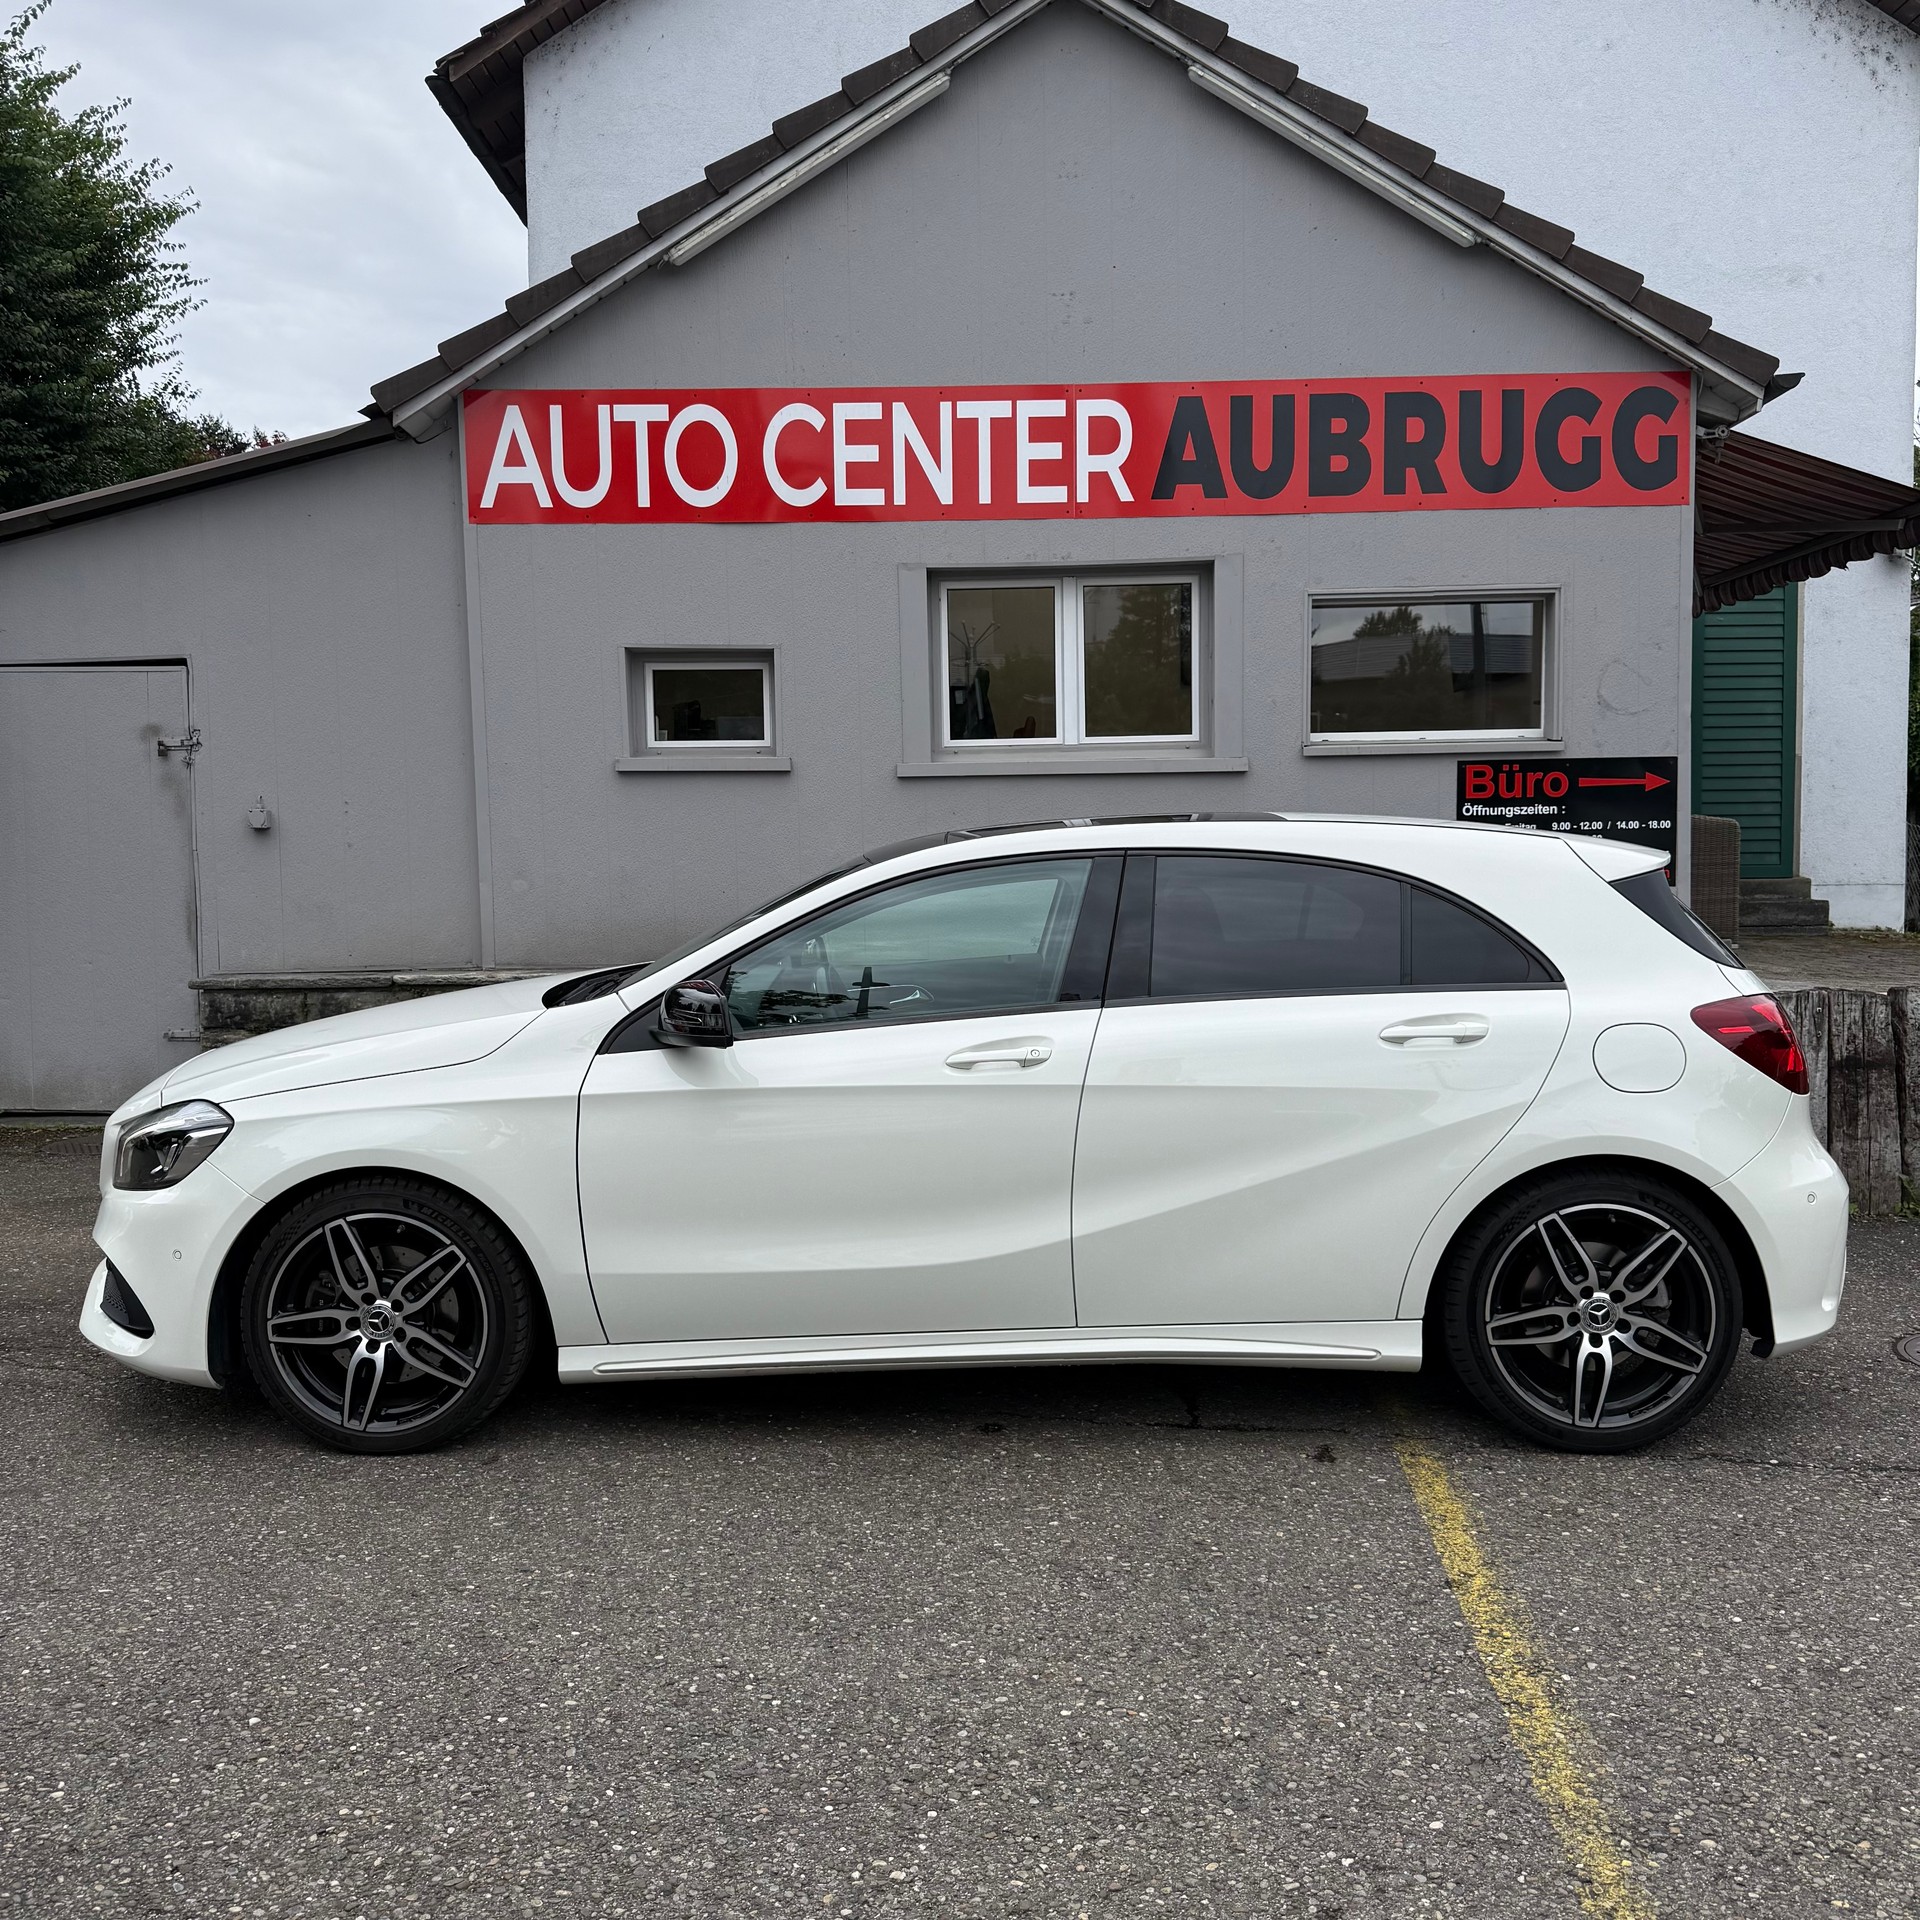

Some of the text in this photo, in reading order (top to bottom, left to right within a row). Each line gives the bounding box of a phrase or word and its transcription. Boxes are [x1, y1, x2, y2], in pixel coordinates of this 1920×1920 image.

[480, 386, 1680, 508] AUTO CENTER AUBRUGG
[1465, 764, 1569, 799] Büro
[1462, 803, 1558, 817] Öffnungszeiten
[1552, 822, 1571, 831] 9.00
[1579, 821, 1603, 830] 12.00
[1616, 820, 1639, 829] 14.00
[1648, 820, 1671, 829] 18.00
[420, 1204, 477, 1249] MICHELIN
